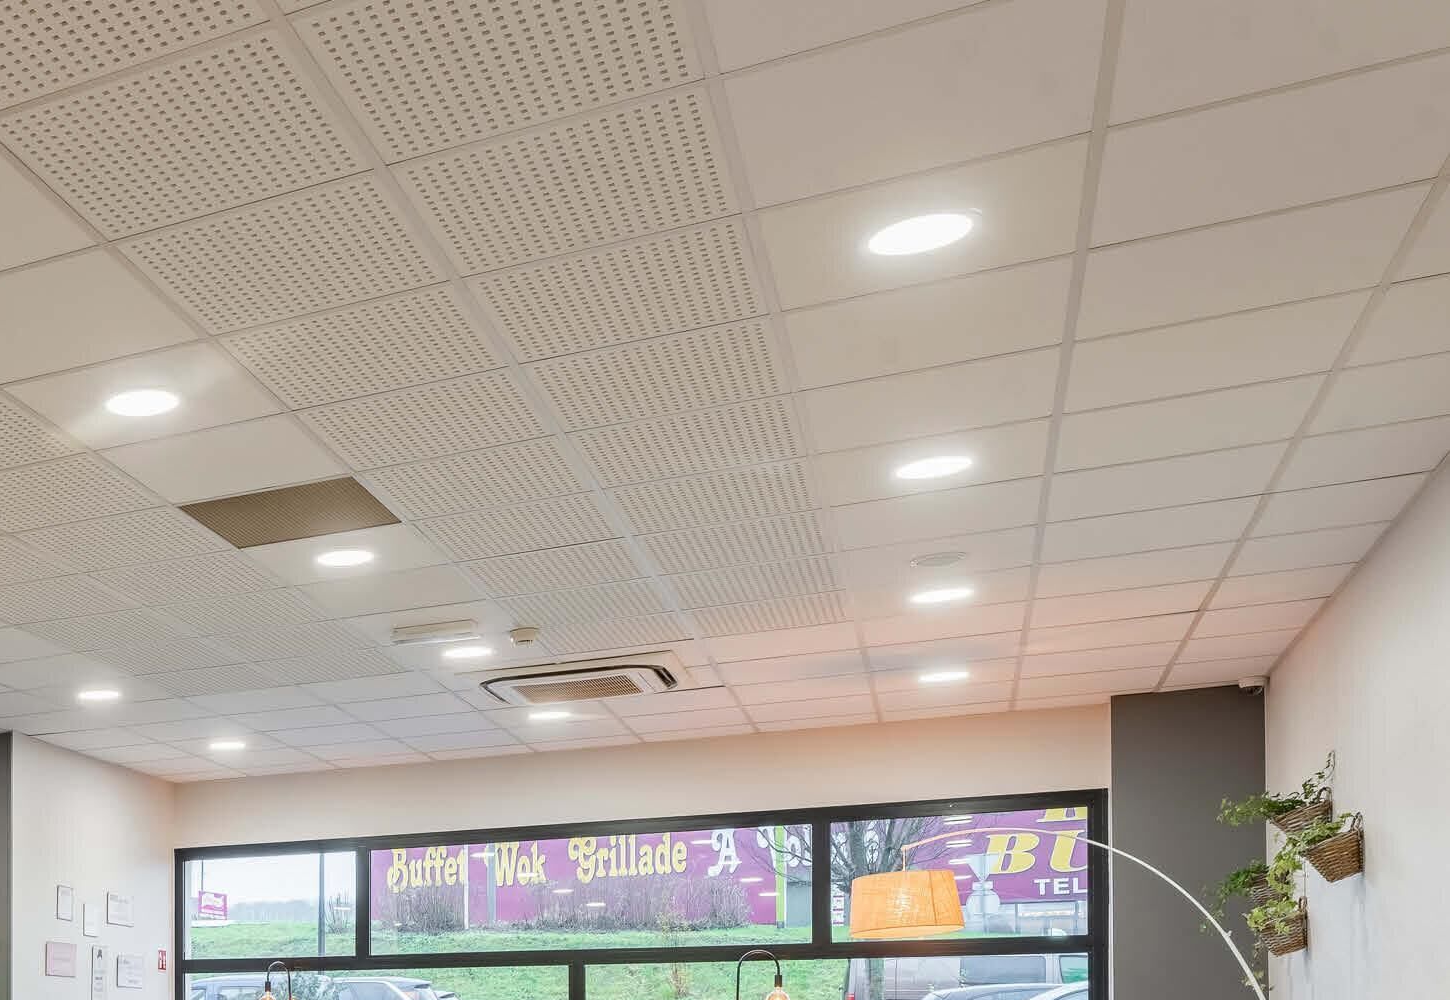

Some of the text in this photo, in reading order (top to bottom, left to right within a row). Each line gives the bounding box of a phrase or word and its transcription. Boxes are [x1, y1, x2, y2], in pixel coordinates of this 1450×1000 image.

[484, 840, 547, 887] Wok
[568, 832, 687, 884] Grillade
[707, 828, 739, 877] A
[1033, 877, 1087, 895] TEL
